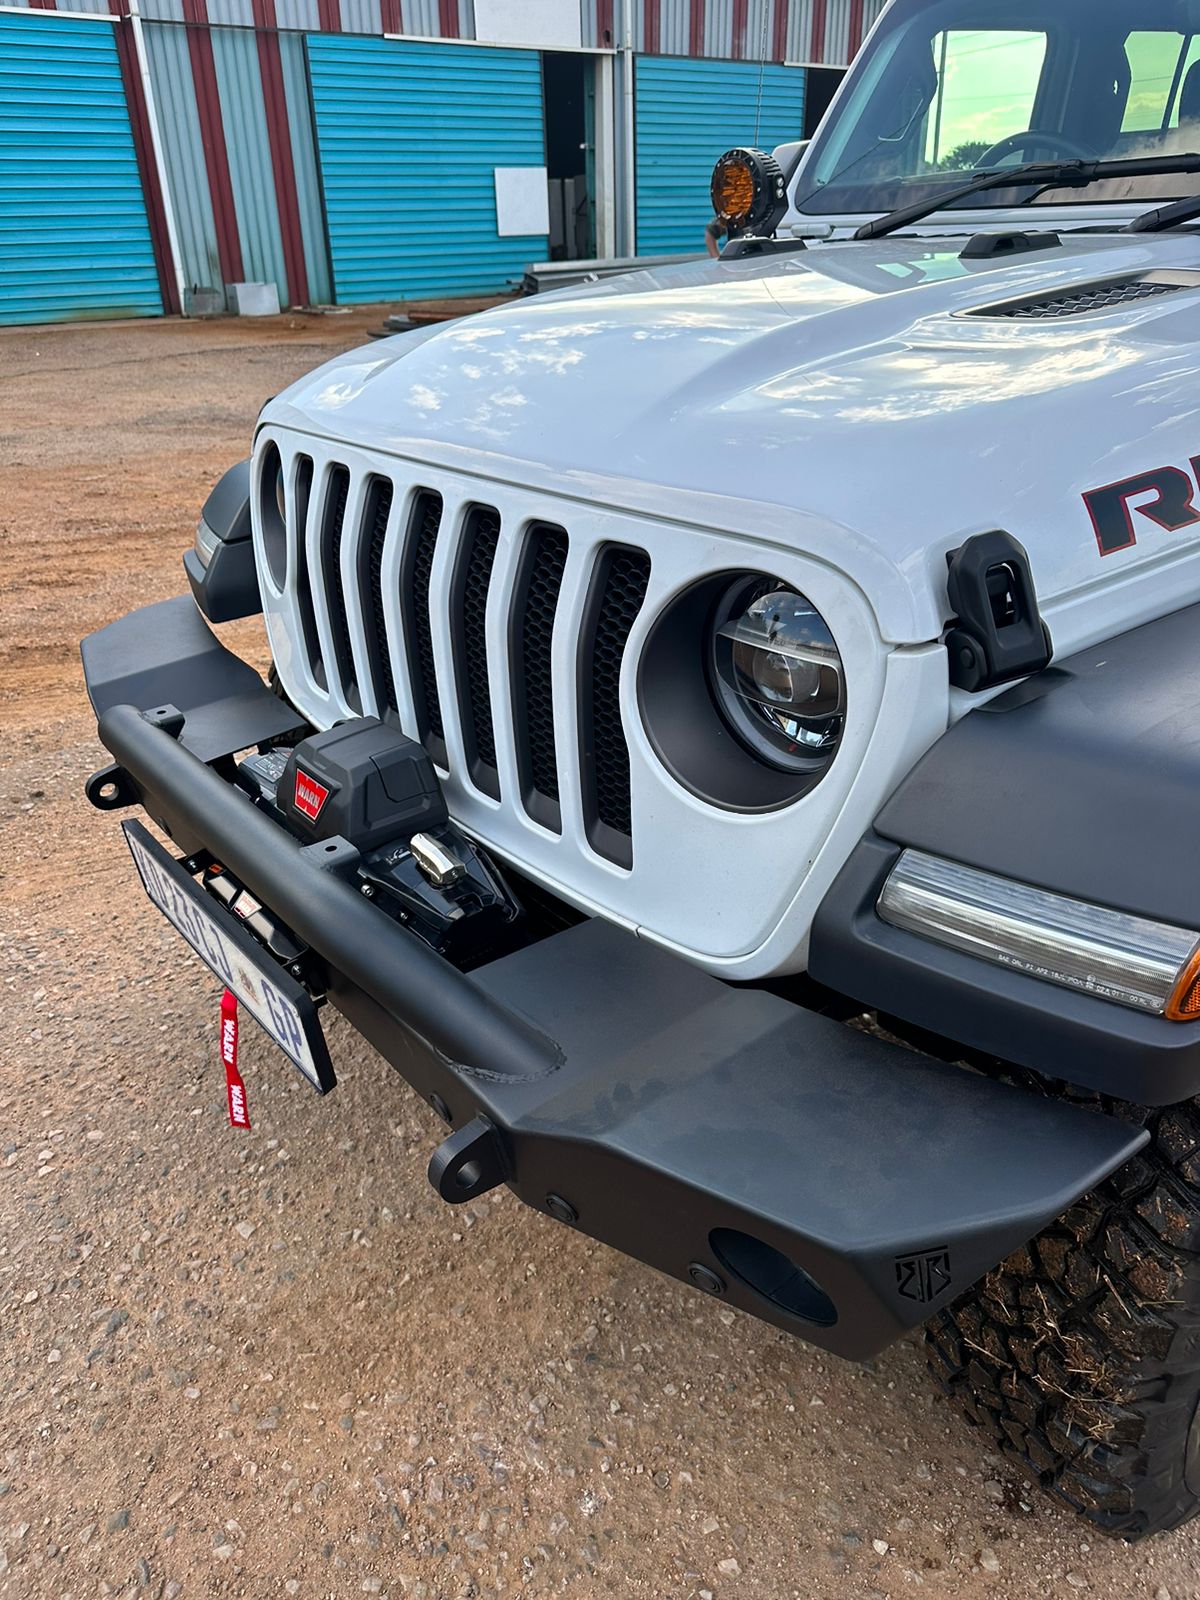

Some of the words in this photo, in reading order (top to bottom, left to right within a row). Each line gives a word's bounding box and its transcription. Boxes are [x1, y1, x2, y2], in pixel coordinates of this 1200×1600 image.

[1081, 455, 1200, 557] R
[298, 783, 320, 809] WARN
[223, 1019, 235, 1064] WARN
[230, 1084, 246, 1123] WARN
